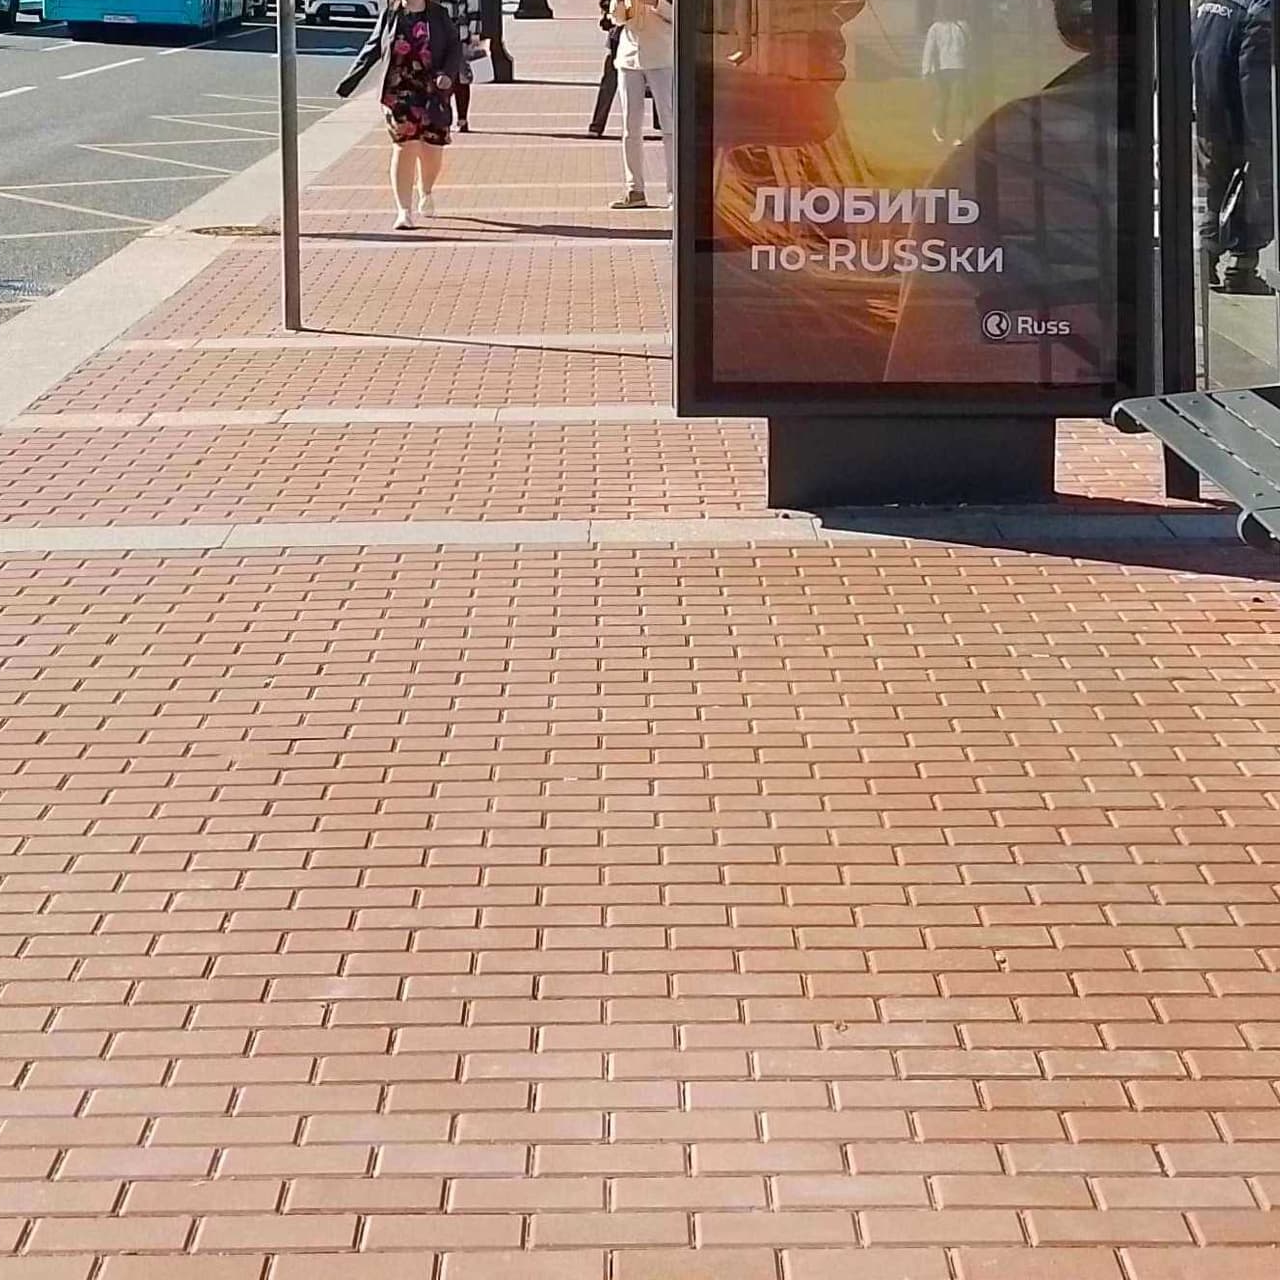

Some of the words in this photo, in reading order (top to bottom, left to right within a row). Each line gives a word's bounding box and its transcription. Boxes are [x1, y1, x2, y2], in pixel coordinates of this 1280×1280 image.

[750, 186, 981, 225] ЛЮБИТЬ
[750, 238, 1004, 273] по-RUSSки
[1016, 316, 1071, 336] Russ
